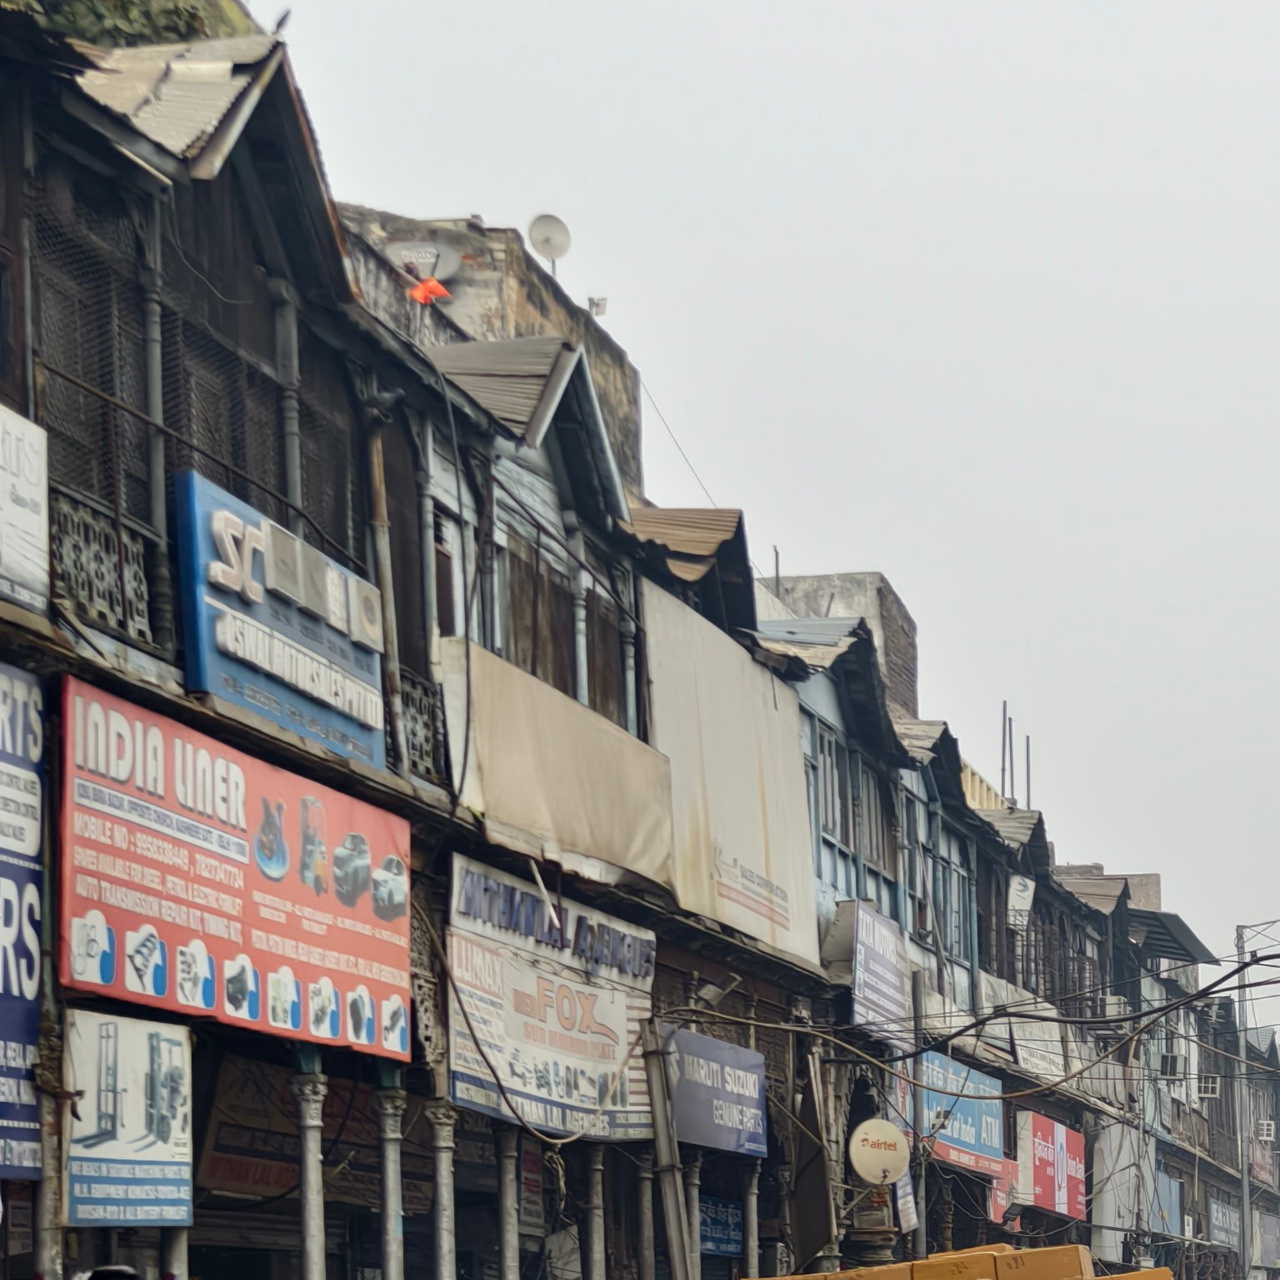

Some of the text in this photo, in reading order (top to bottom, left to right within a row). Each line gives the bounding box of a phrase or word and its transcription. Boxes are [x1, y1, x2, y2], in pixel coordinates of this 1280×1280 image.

[75, 695, 165, 799] INDIA
[74, 810, 112, 846] MOBILE
[113, 823, 128, 851] NO
[537, 976, 619, 1046] FOX
[683, 1053, 759, 1099] MARUTI SUZUKI
[713, 1098, 742, 1130] GENUINE
[981, 1113, 999, 1149] ATM
[870, 1138, 897, 1152] airtel
